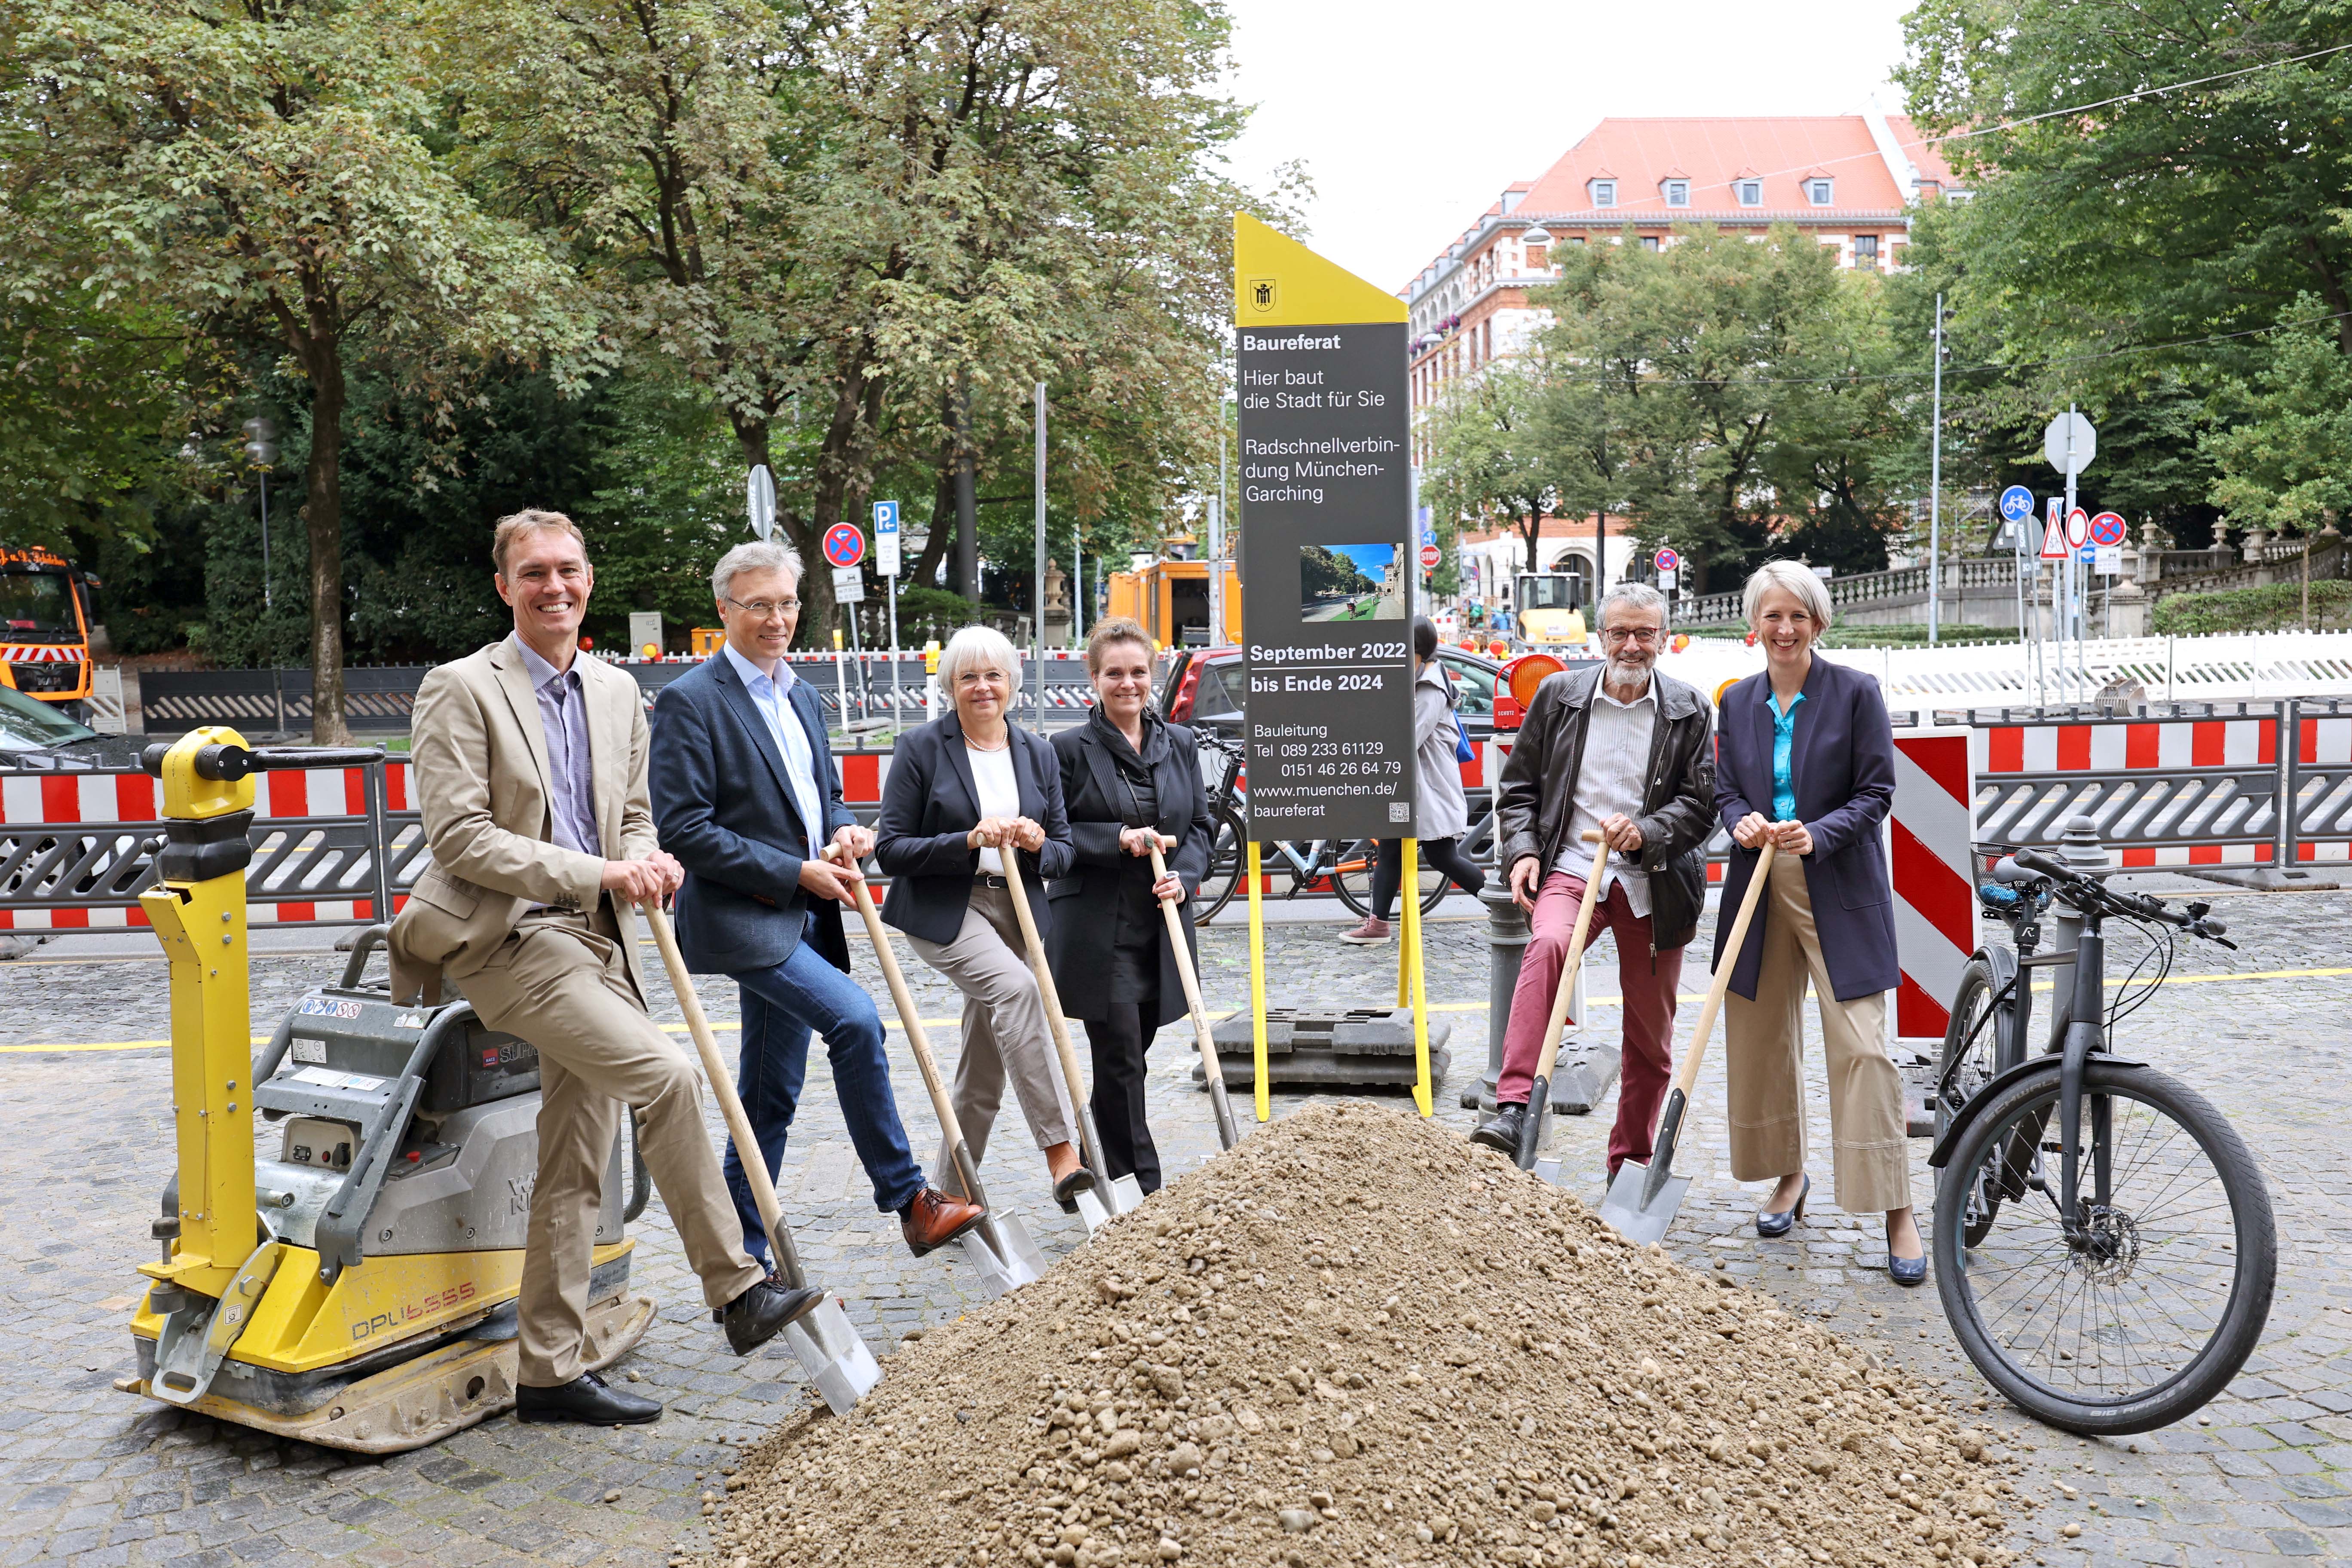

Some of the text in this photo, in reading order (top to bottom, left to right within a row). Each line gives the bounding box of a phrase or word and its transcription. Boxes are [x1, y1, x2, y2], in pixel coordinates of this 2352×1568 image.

[1244, 334, 1341, 351] Baureferat
[1244, 369, 1323, 385] Hier baut
[1244, 391, 1384, 408] die Stadt für Sie
[1246, 436, 1400, 455] Radschnellverbin-
[1246, 461, 1384, 481] dung München-
[1246, 485, 1323, 503] Garching
[1421, 551, 1439, 561] STOP
[1250, 643, 1406, 664] September 2022
[1251, 675, 1383, 692] bis Ende 2024
[1255, 724, 1327, 738] Bauleitung
[1254, 742, 1383, 756] Tel 089 233 61129
[1282, 762, 1401, 776] 0151 46 26 64 79
[1253, 782, 1397, 797] www.muenchen.de/
[1255, 804, 1325, 817] baureferat
[932, 1071, 942, 1085] profi
[2123, 1389, 2176, 1414] APPLE
